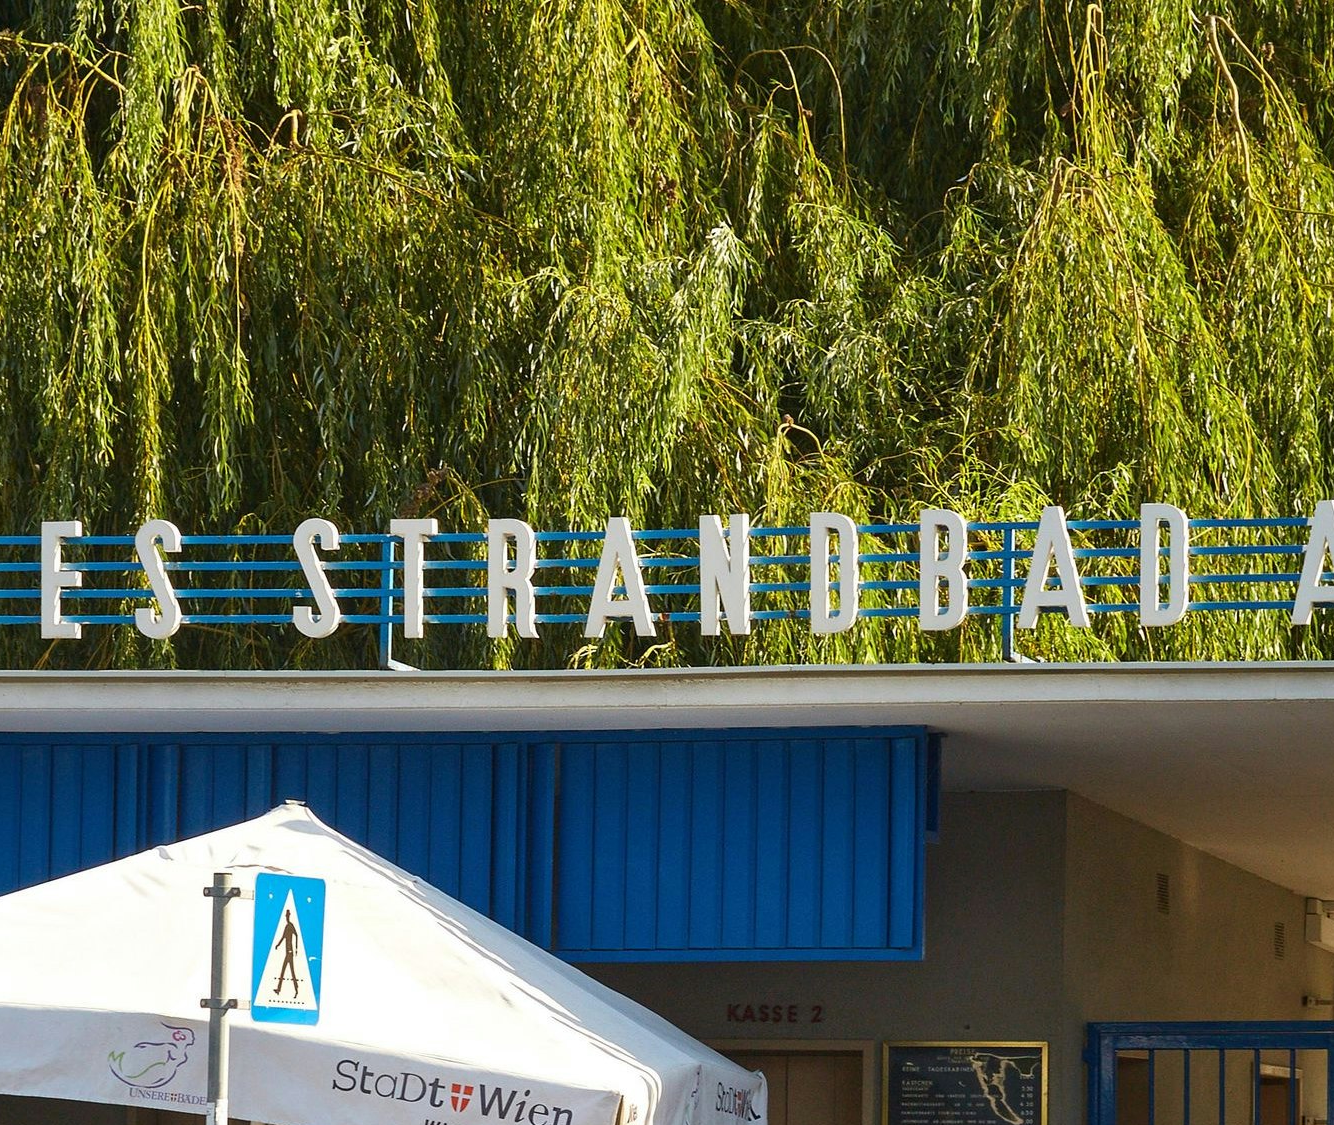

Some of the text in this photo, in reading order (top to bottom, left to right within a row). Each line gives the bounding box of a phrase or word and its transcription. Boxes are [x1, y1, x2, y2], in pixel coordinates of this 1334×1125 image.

[292, 503, 1191, 640] STRANDBAD
[727, 1003, 824, 1023] KASSE 2
[129, 1087, 207, 1106] UNSERE BÄDE
